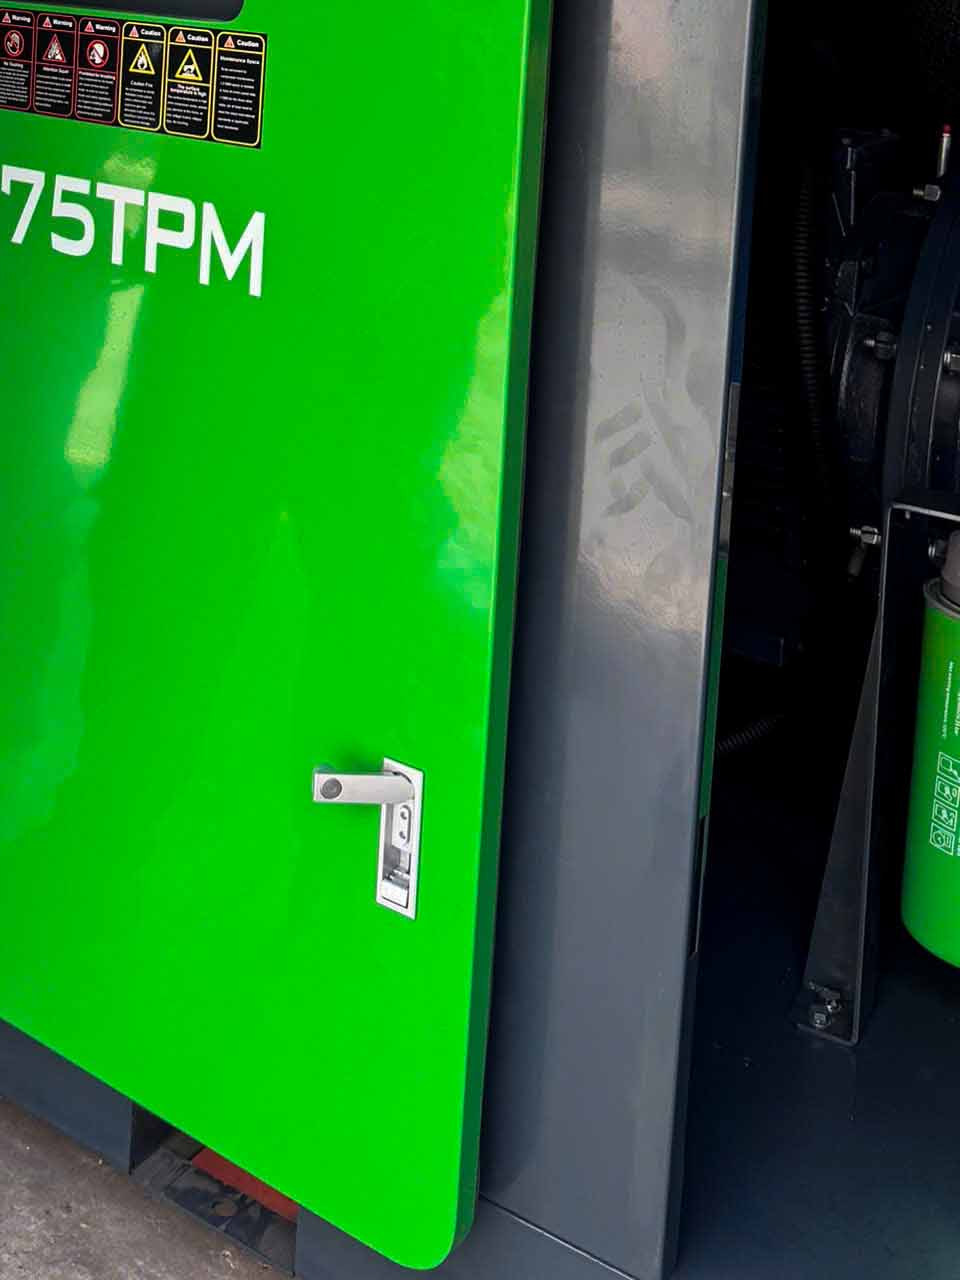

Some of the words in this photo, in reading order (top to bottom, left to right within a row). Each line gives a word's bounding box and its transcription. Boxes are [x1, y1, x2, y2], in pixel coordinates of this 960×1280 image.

[11, 14, 31, 23] Warning
[53, 18, 73, 28] Warning
[95, 23, 116, 33] Warning
[140, 28, 161, 37] Caution
[186, 33, 209, 42] Caution
[236, 39, 260, 48] Caution
